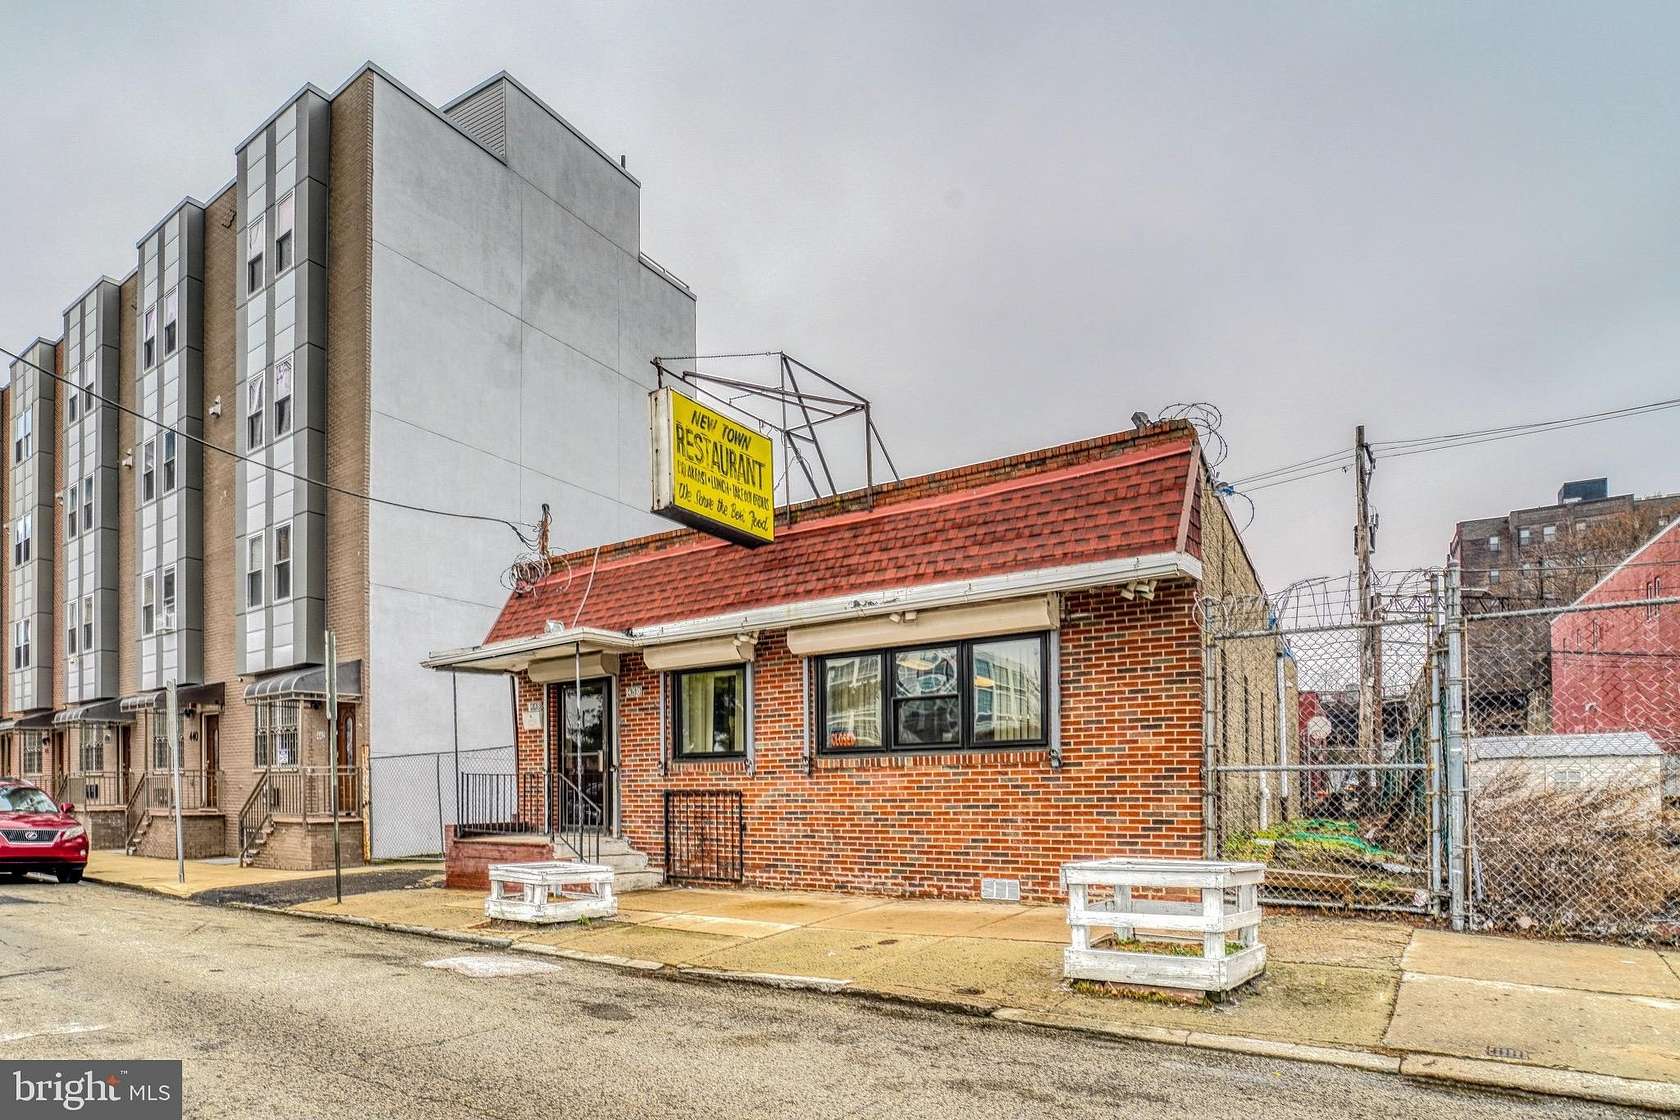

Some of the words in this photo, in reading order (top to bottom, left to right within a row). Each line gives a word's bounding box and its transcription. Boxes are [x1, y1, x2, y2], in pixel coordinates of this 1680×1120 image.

[691, 410, 717, 433] NEW
[722, 424, 751, 451] TOWN
[675, 423, 766, 490] RESTAURANT
[711, 474, 730, 495] LUNCH
[748, 510, 769, 532] Food
